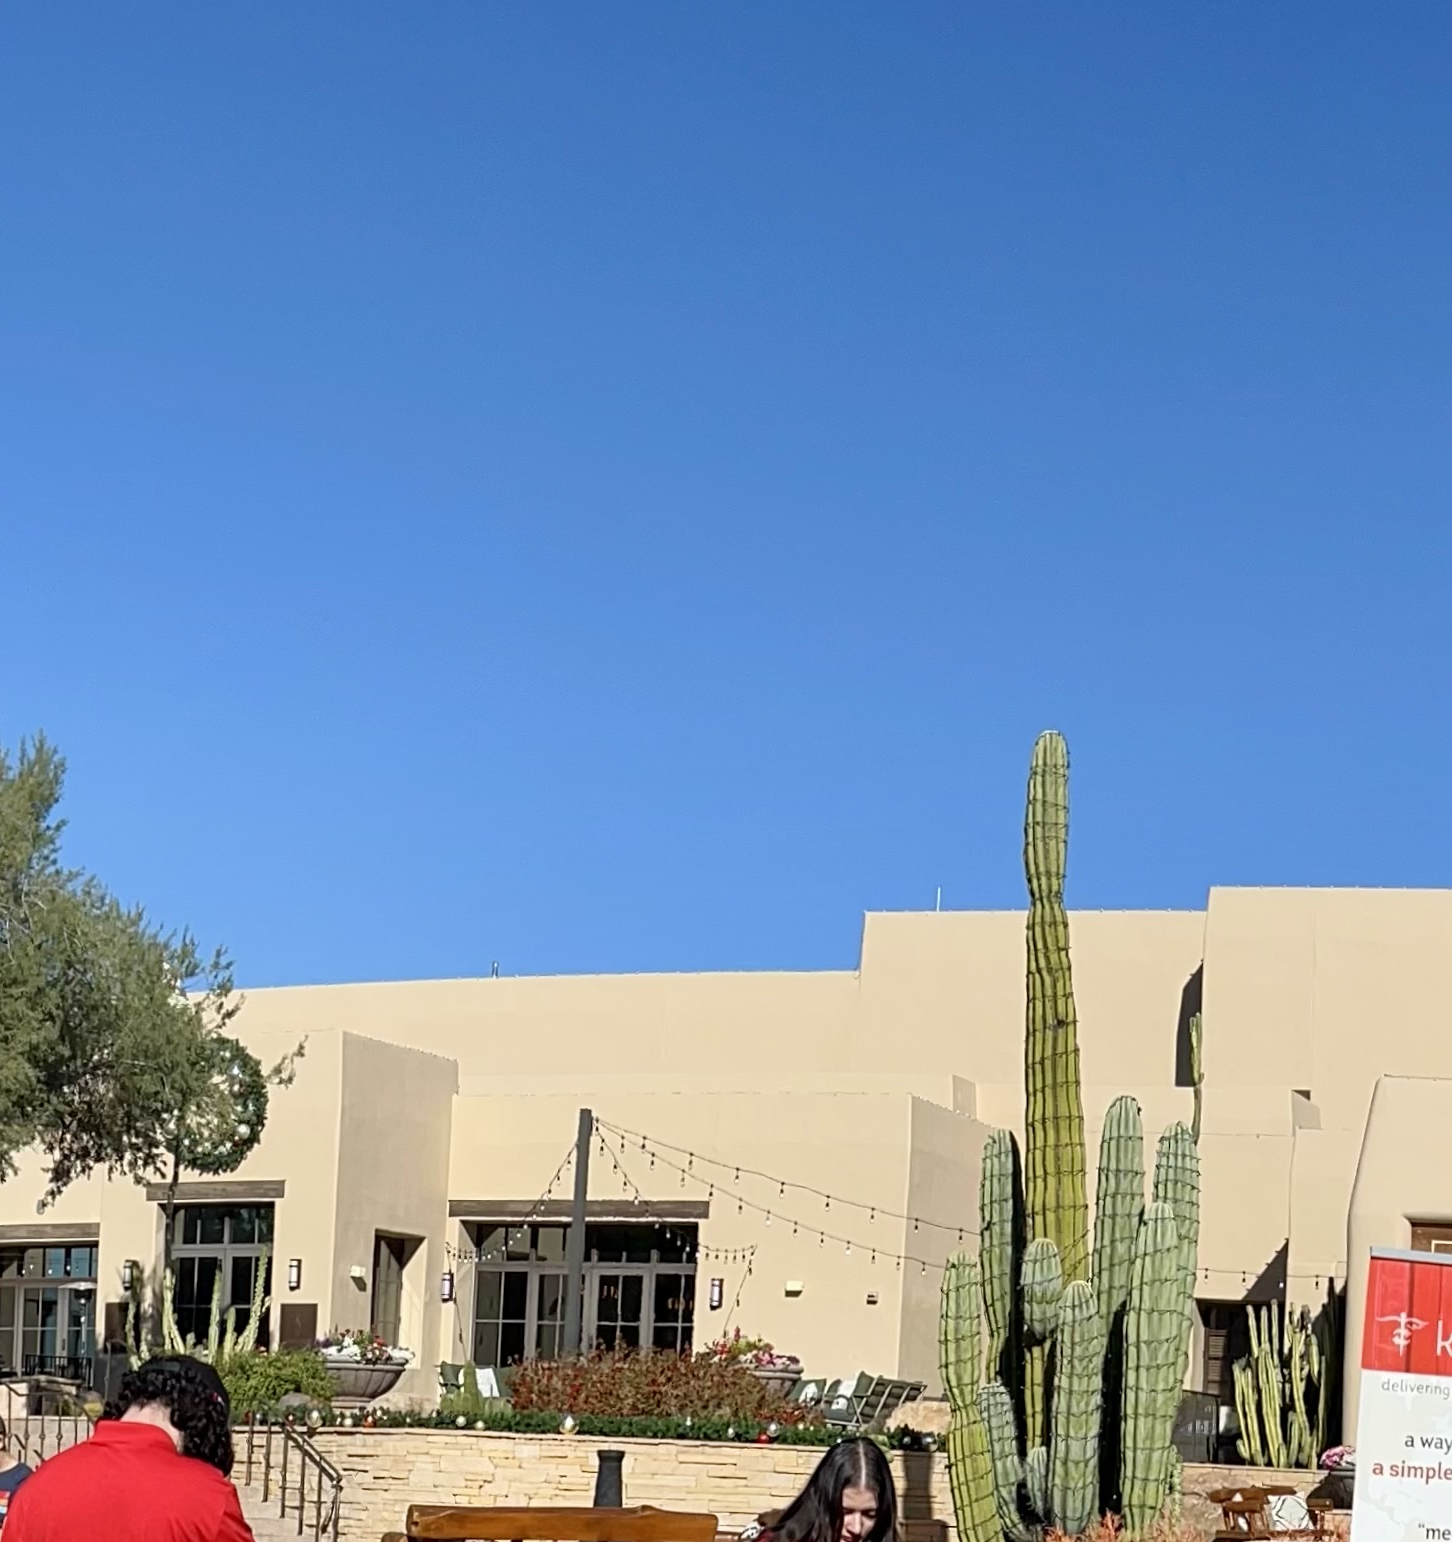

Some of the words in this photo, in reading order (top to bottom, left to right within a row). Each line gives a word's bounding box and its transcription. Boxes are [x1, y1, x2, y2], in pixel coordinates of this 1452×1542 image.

[1381, 1378, 1451, 1400] delivering
[1404, 1434, 1415, 1448] a
[1371, 1461, 1385, 1476] a
